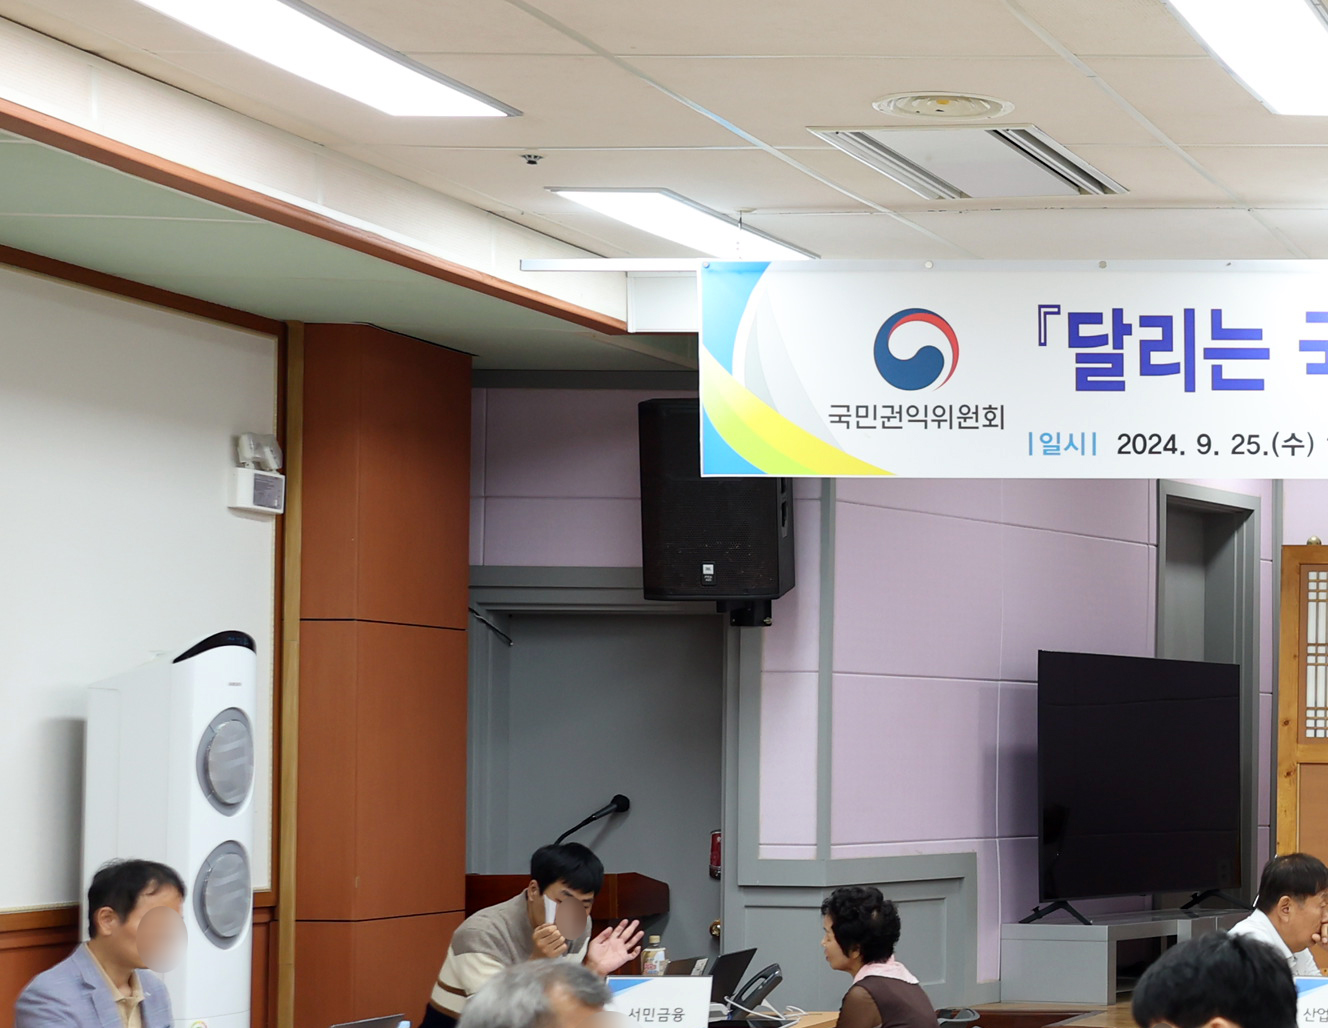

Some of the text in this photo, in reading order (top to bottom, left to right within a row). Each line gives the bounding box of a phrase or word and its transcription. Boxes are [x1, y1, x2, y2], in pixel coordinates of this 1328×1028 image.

[1034, 303, 1271, 394] 『달리는
[828, 403, 1005, 431] 국민권익위원회
[1116, 432, 1186, 456] 2024.
[1196, 432, 1220, 456] 9.
[1230, 431, 1315, 458] 25.(수)
[628, 1007, 686, 1023] 서민금융
